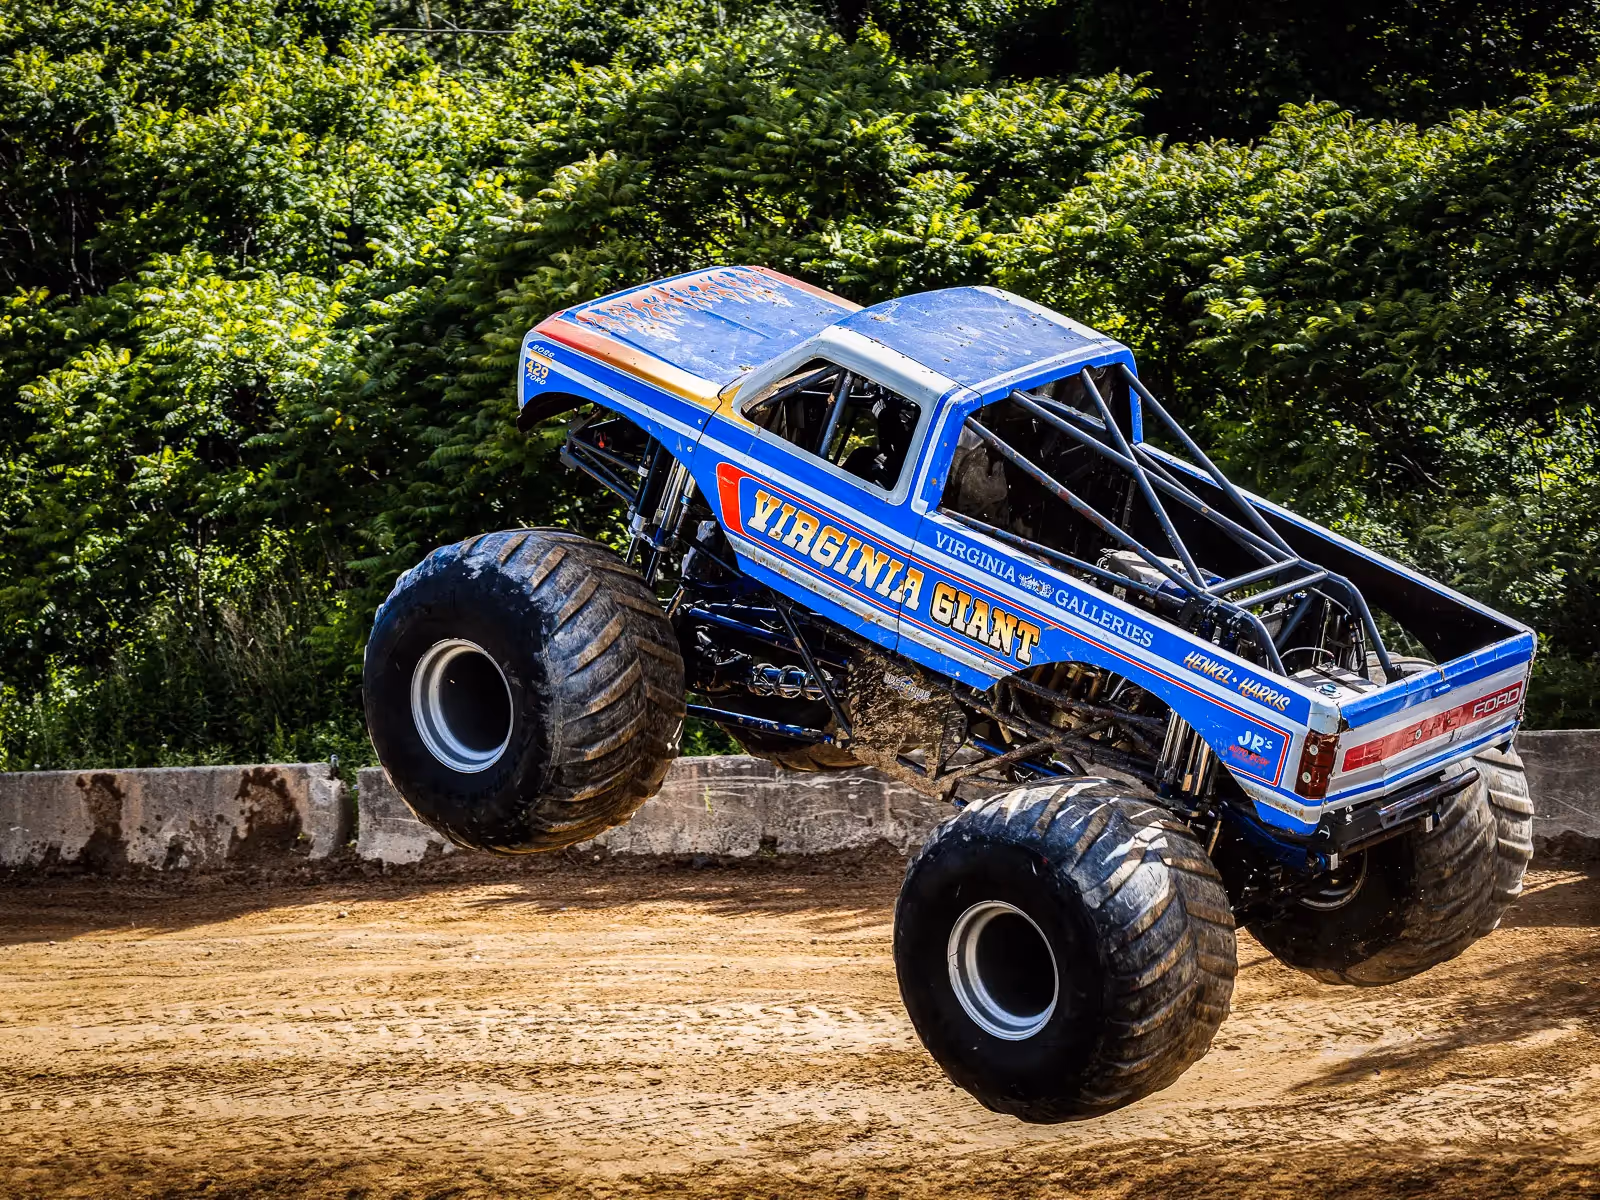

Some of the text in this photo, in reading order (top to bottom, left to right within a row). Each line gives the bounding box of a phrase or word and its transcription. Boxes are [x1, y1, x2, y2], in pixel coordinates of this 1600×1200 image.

[532, 344, 555, 358] BOSS
[525, 373, 546, 384] FORD
[526, 360, 548, 378] 429
[747, 489, 1041, 666] VIRGINIA GIANT
[935, 530, 1154, 648] VIRGINIA GALLERIES
[1183, 650, 1291, 712] HENKEL HARRIS
[1472, 687, 1520, 718] FORD
